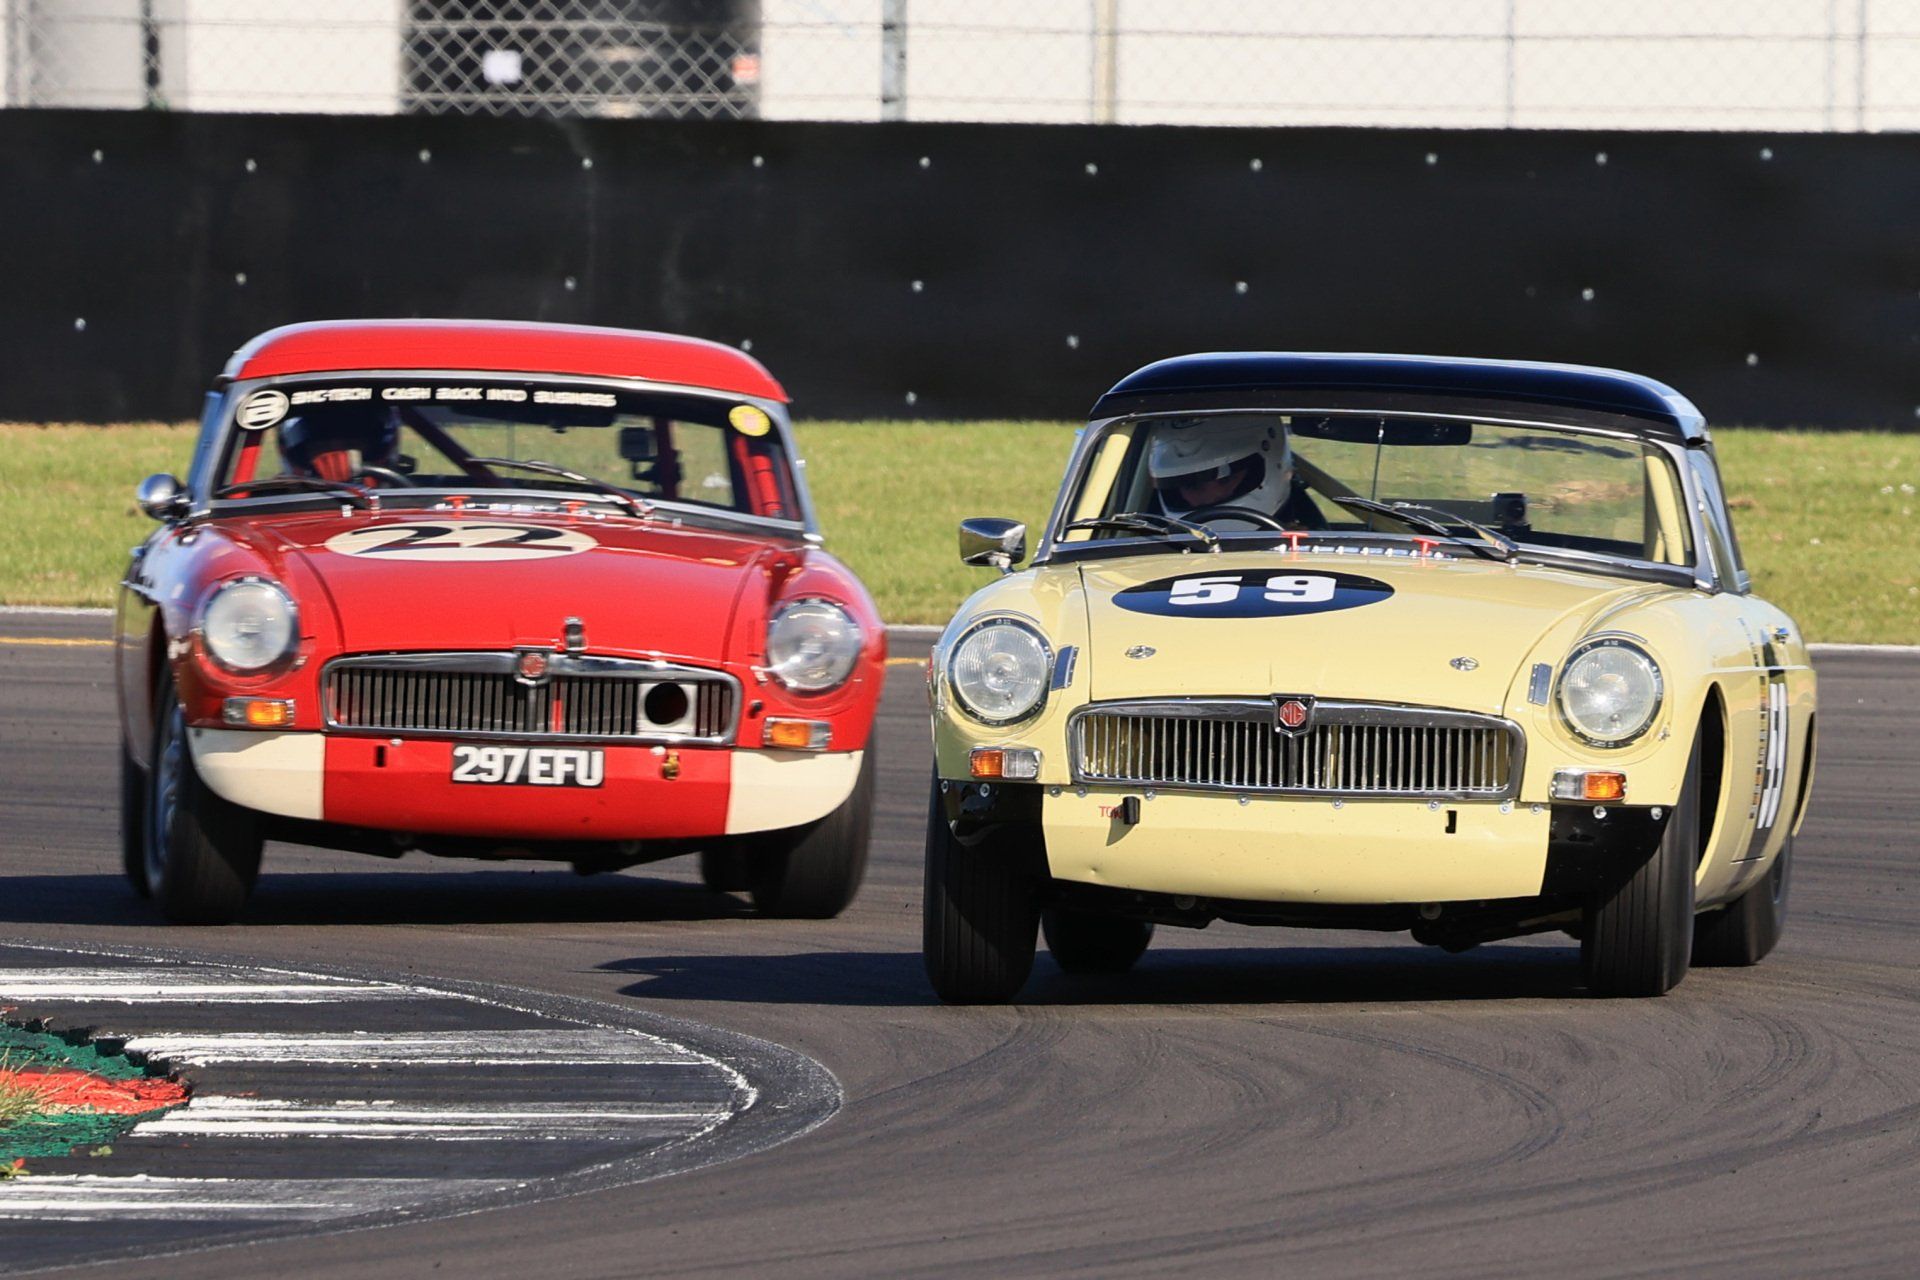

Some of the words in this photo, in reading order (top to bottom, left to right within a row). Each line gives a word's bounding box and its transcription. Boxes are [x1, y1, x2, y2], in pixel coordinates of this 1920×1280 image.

[381, 387, 431, 400] CASH
[435, 387, 483, 400] BACK
[486, 388, 528, 402] INTO
[533, 390, 617, 407] BUSINESS
[351, 525, 573, 555] 22
[1168, 575, 1337, 605] 59
[1282, 702, 1304, 724] MG
[452, 746, 604, 786] 297EFU
